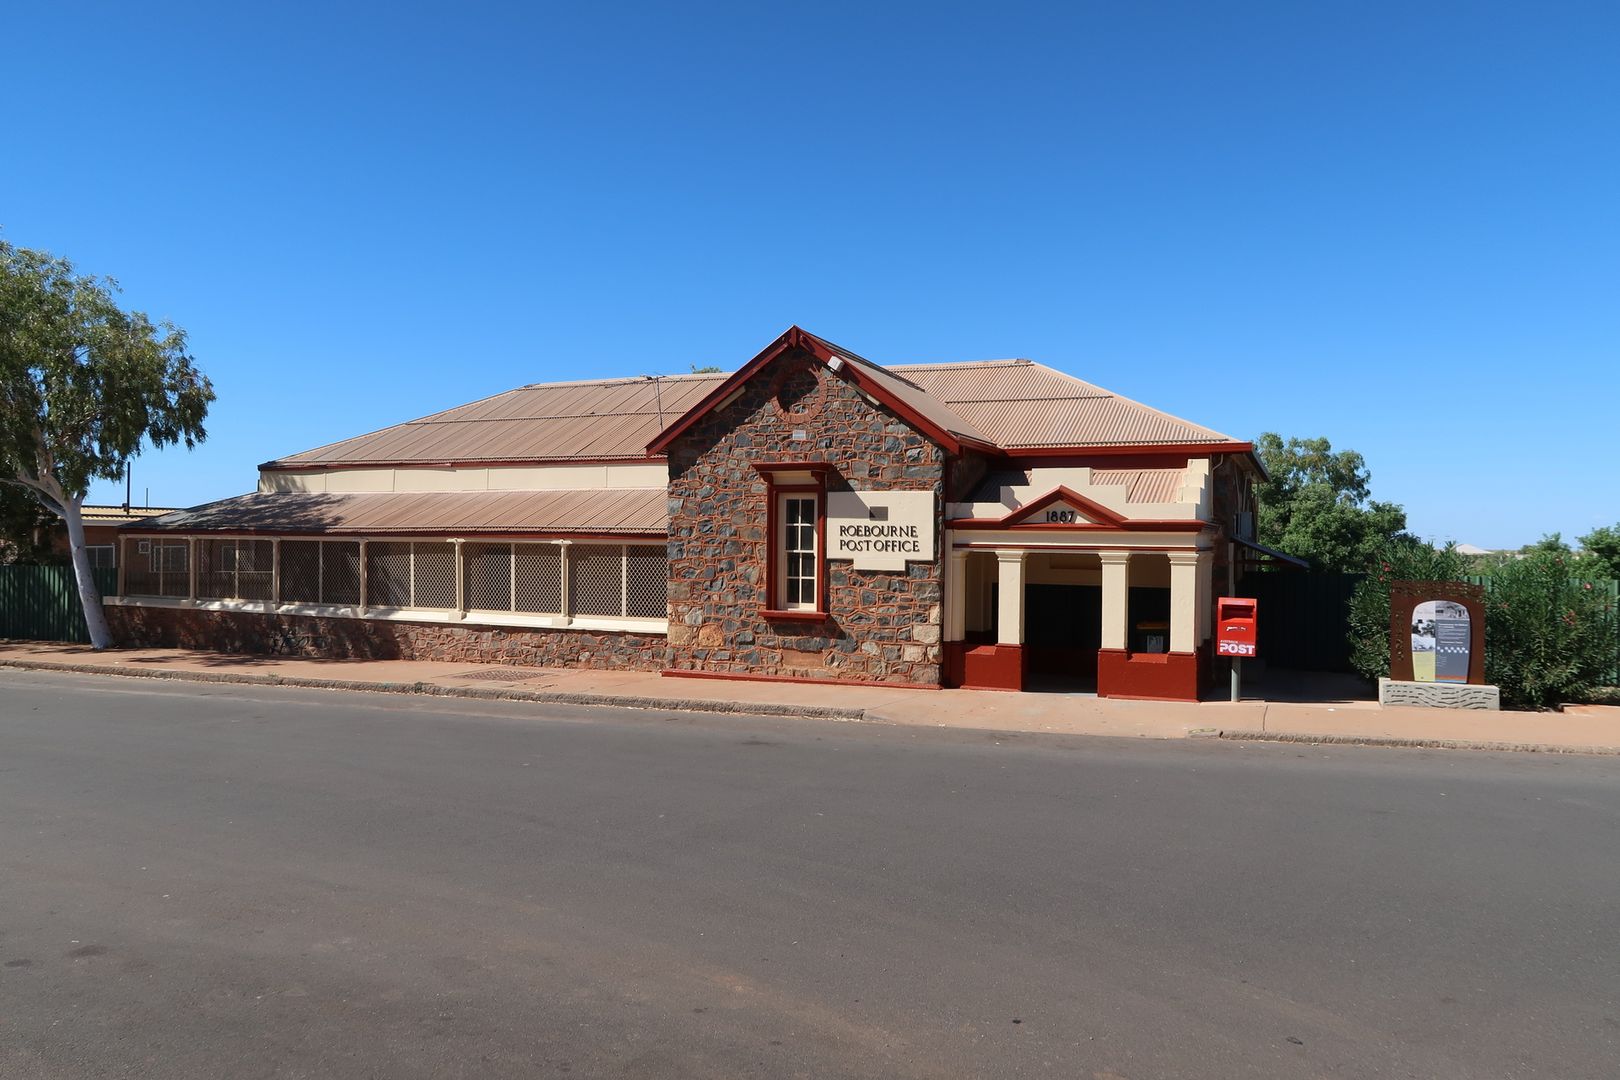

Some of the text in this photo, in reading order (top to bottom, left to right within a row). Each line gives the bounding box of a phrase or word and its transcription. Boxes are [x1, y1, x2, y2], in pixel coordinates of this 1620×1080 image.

[1046, 510, 1075, 522] 1887
[839, 525, 918, 538] ROEBOURNE
[839, 540, 920, 552] POST OFFICE
[1219, 643, 1255, 655] POST
